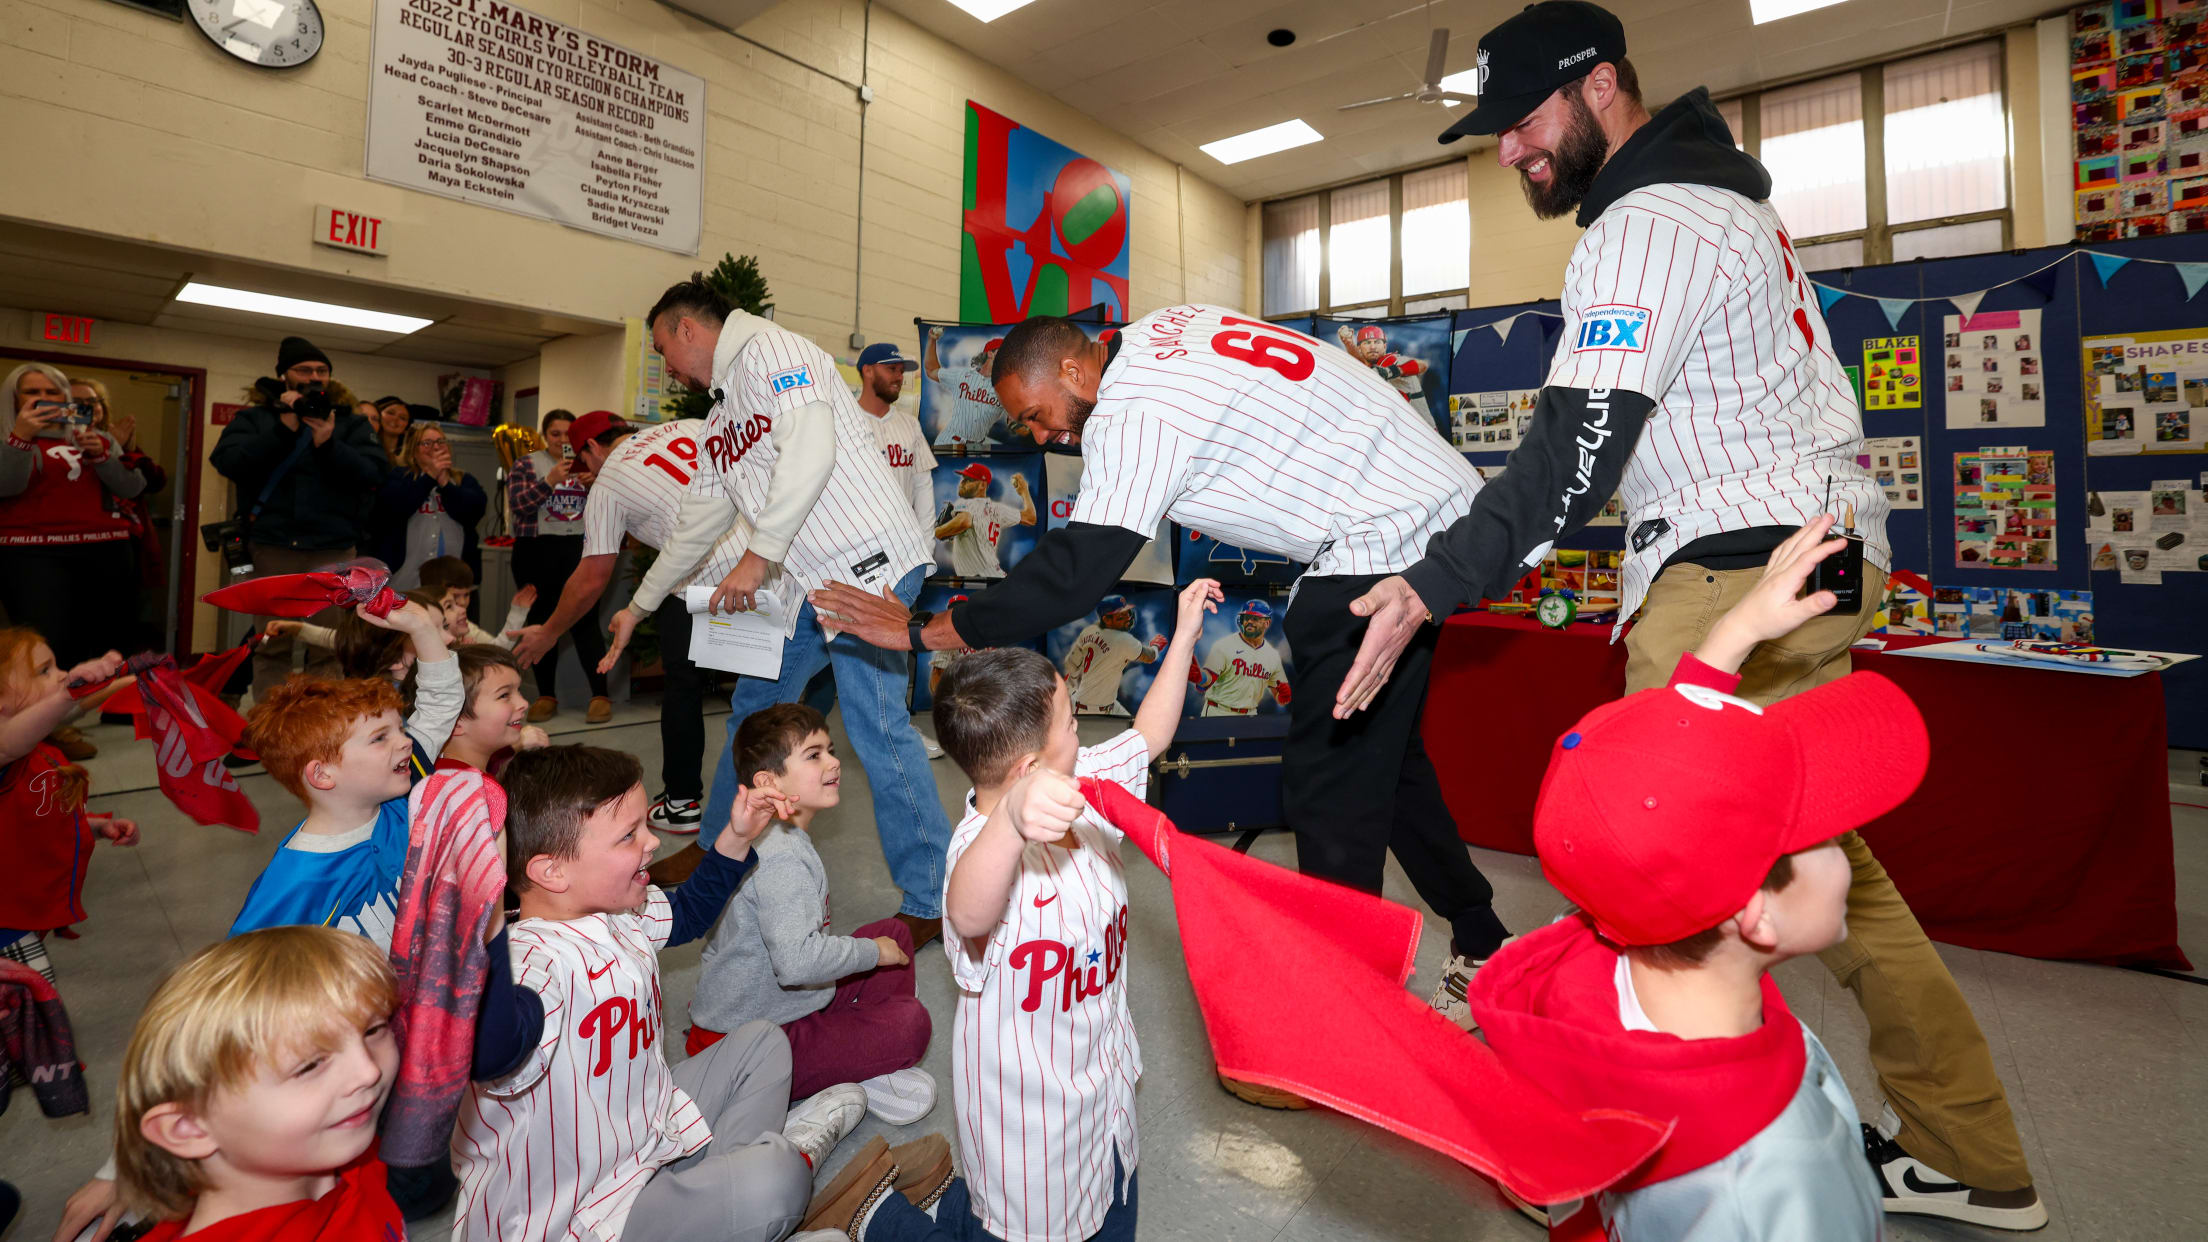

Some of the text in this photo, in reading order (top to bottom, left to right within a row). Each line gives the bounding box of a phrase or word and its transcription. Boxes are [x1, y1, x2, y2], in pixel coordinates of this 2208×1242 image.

[291, 38, 300, 49] 4
[298, 22, 308, 34] 3
[273, 44, 284, 57] 5
[400, 8, 689, 124] REGULAR SEASON CYO REGION 6 CHAMPIONS
[408, 0, 685, 106] 2022 CYO GIRLS VOLLEYBALL TEAM
[586, 39, 660, 81] STORM
[1558, 47, 1598, 70] PROSPER
[384, 64, 416, 83] Head
[420, 75, 457, 95] Coach
[467, 90, 498, 108] Steve
[501, 101, 551, 125] DeCesare
[398, 53, 435, 73] Jayda
[438, 65, 486, 90] Pugliese
[496, 85, 543, 108] Principal
[447, 48, 655, 130] 30-3 REGULAR SEASON RECORD
[418, 95, 531, 137] Scarlet McDermott
[425, 112, 522, 148] Emme Grandizio
[426, 126, 520, 160] Lucia DeCesare
[575, 111, 612, 130] Assistant
[614, 124, 638, 139] Coach
[643, 133, 661, 146] Beth
[662, 139, 695, 157] Grandizio
[575, 125, 612, 144] Assistant
[613, 138, 638, 152] Coach
[643, 146, 662, 159] Chris
[663, 152, 695, 169] Isaacson
[414, 138, 531, 177] Jacquelyn Shapson
[418, 153, 525, 190] Daria Sokolowska
[591, 160, 662, 188] Isabella Fisher
[597, 150, 658, 175] Anne Berger
[428, 170, 515, 200] Maya Eckstein
[580, 183, 670, 215] Claudia Kryszczak
[596, 174, 658, 200] Peyton Floyd
[587, 198, 664, 226] Sadie Murawski
[592, 212, 659, 237] Bridget Vezza
[329, 209, 382, 250] EXIT
[44, 313, 95, 344] EXIT
[1577, 319, 1644, 349] IBX
[1864, 337, 1918, 350] BLAKE
[1211, 316, 1321, 381] 61
[772, 371, 811, 392] IBX
